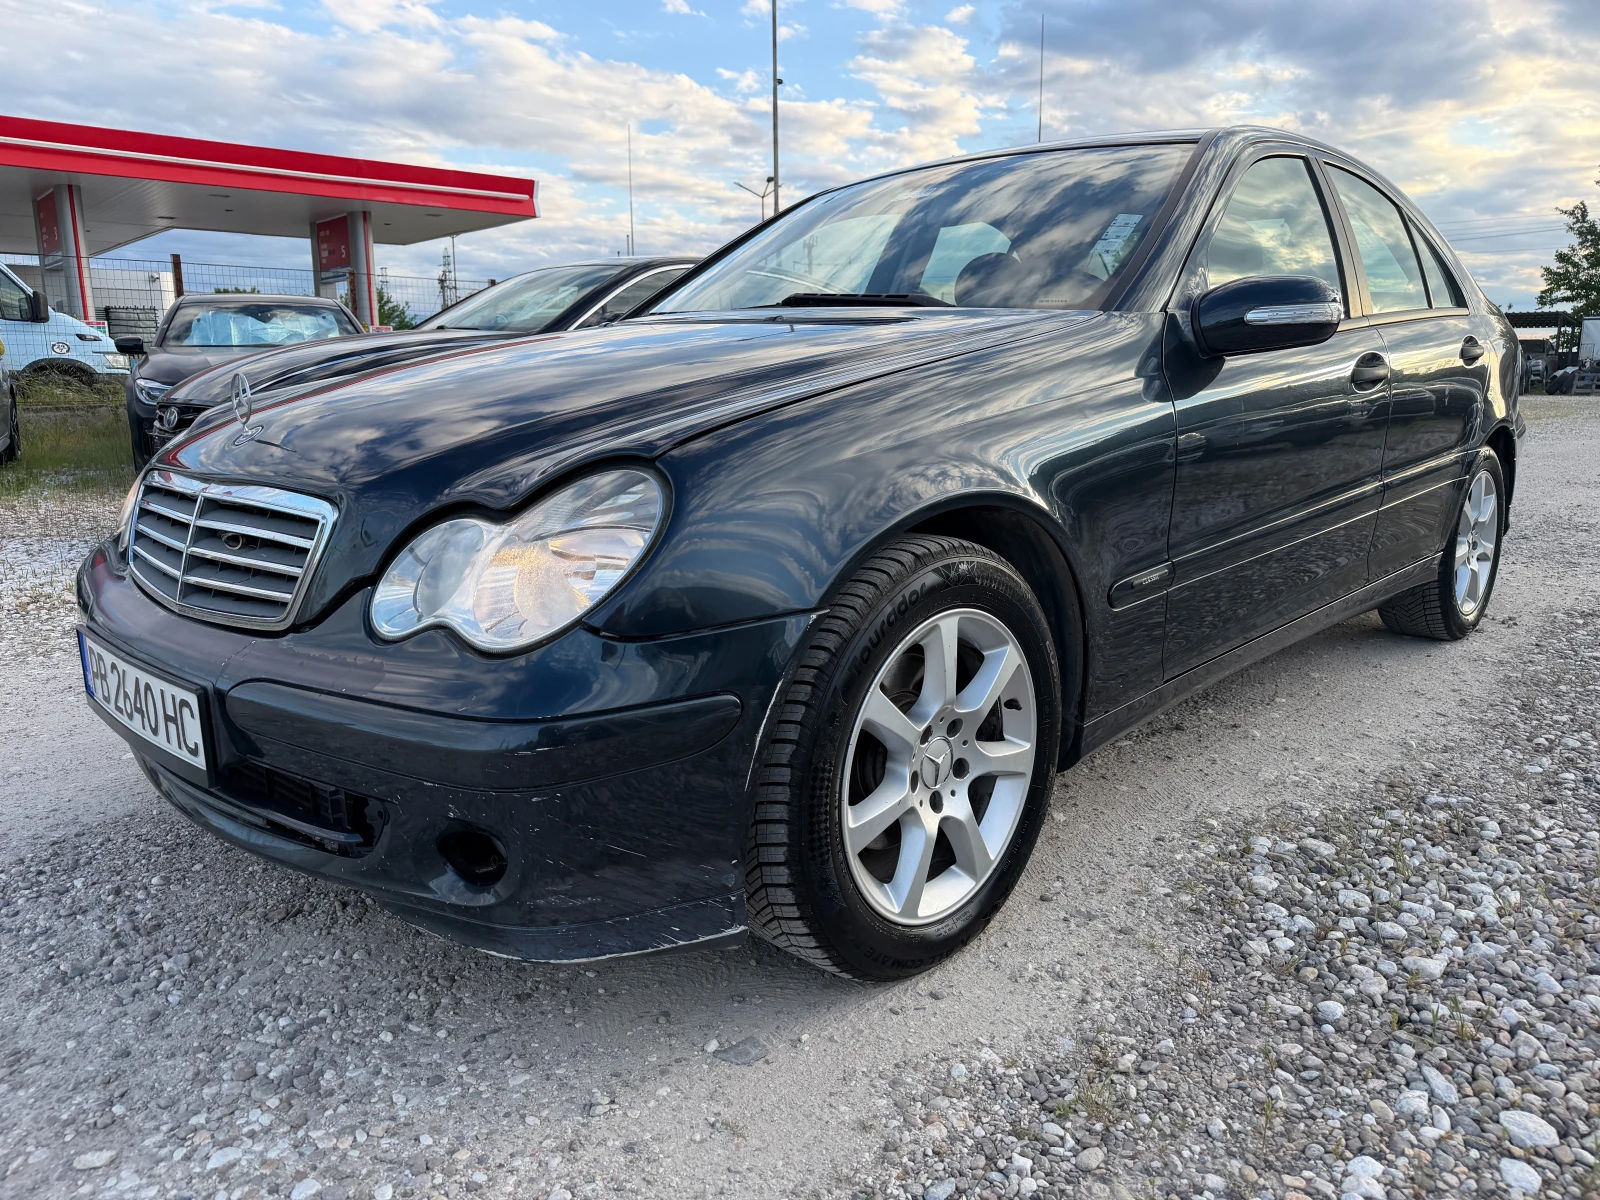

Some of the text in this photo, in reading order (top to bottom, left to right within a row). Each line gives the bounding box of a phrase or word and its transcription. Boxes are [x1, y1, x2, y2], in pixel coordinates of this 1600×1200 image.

[53, 226, 58, 241] 3
[340, 244, 346, 258] 5
[88, 645, 199, 758] PB 2640 HC
[862, 947, 924, 969] CLIMATE
